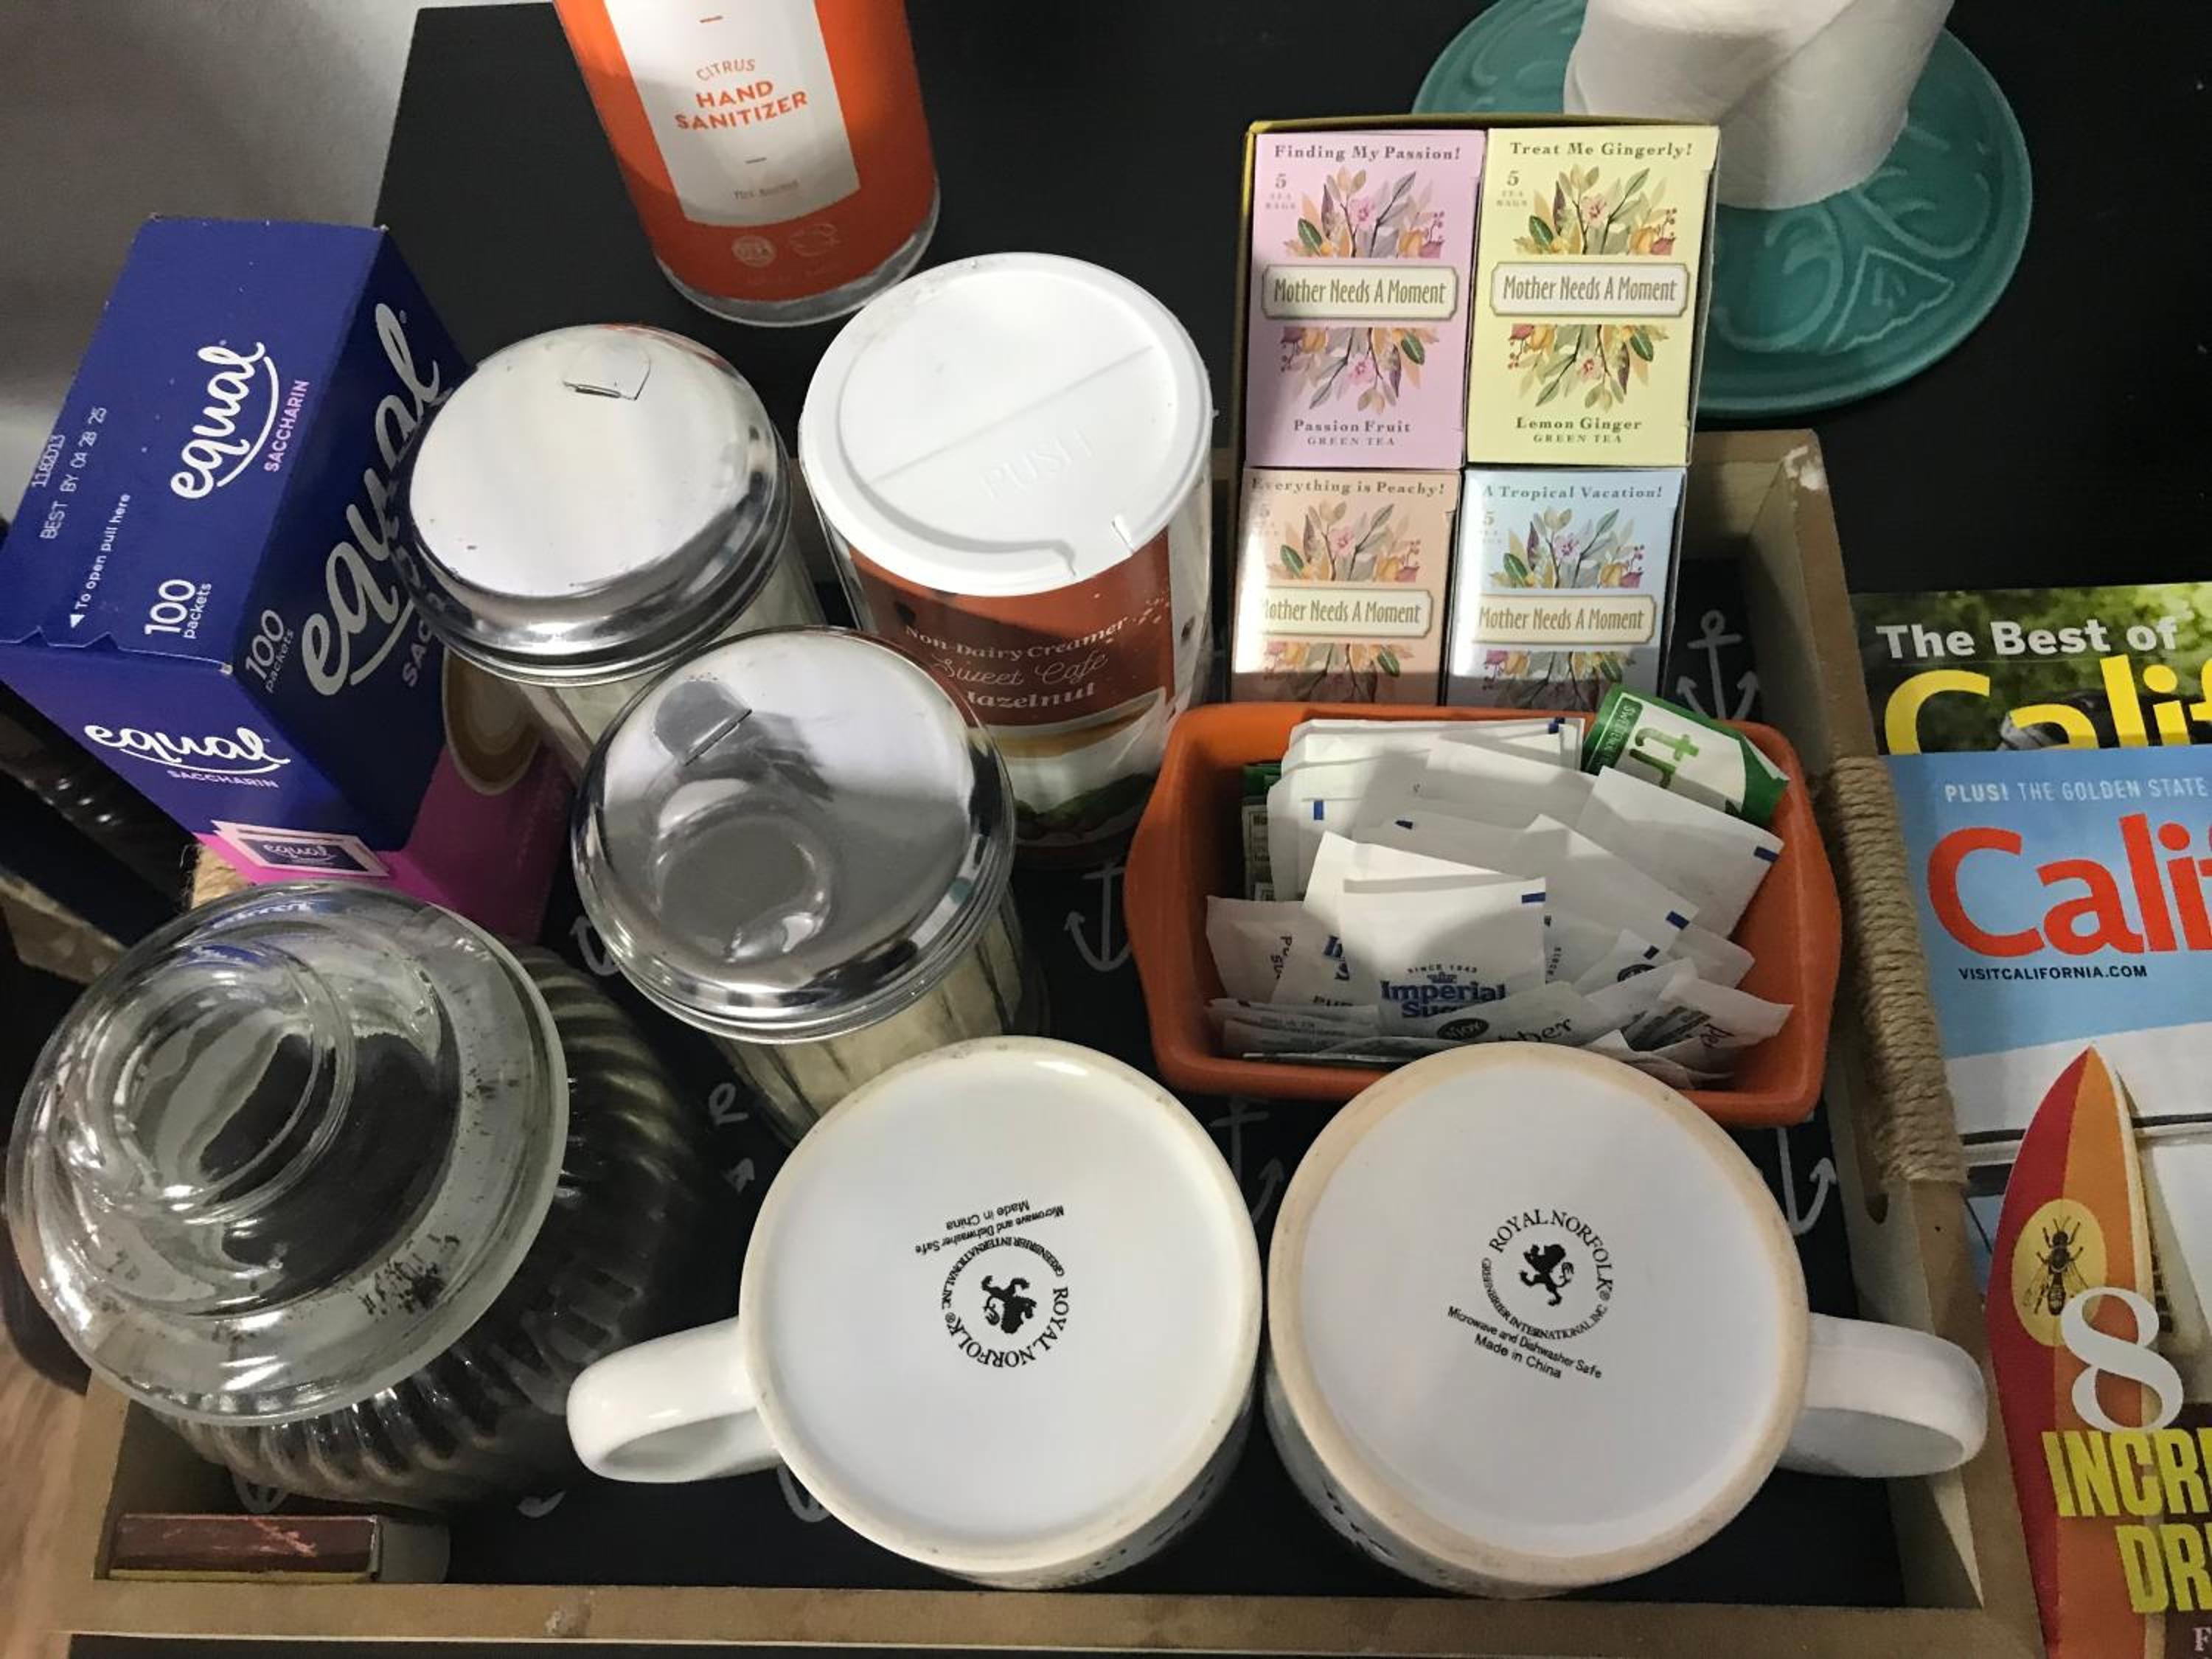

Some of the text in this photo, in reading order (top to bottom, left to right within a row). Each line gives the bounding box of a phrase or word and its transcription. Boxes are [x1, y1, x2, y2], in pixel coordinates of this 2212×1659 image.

[695, 58, 756, 81] CITRUS
[695, 80, 774, 109] HAND
[674, 91, 808, 131] SANITIZER
[1274, 145, 1461, 161] Finding My Passion!
[1510, 142, 1694, 159] Treat Me Gingerly!
[1275, 173, 1287, 189] 5
[1506, 170, 1520, 187] 5
[1273, 278, 1447, 305] Mother Needs A Moment
[1503, 275, 1677, 302] Mother Needs A Moment
[170, 341, 267, 500] equal
[264, 379, 310, 473] SACCHARIN
[1293, 420, 1411, 433] Passion Fruit
[1516, 417, 1643, 434] Lemon Ginger
[1307, 437, 1396, 446] GREEN TEA
[1533, 434, 1622, 443] GREEN TEA
[978, 426, 1097, 501] PUSH
[1357, 481, 1371, 493] is
[1376, 481, 1444, 497] Peachy!
[1482, 485, 1663, 501] A Tropical Vacation!
[39, 501, 68, 539] BEST
[60, 473, 79, 492] BY
[74, 493, 131, 610] To open pull here
[145, 579, 195, 636] 100
[182, 582, 212, 640] packets
[1309, 599, 1349, 623] Needs
[1352, 599, 1361, 622] A
[1366, 599, 1423, 625] Moment
[1479, 606, 1645, 631] Mother Needs A Moment
[246, 610, 285, 680] 100
[906, 616, 1127, 664] Non-Dairy Creamer
[1876, 616, 2179, 660] The Best of
[265, 629, 296, 695] packets
[931, 653, 1025, 686] Sweet
[83, 724, 292, 764] equal
[167, 770, 279, 789] SACCHARIN
[1944, 776, 2208, 804] PLUS! THE GOLDEN STATE
[1408, 964, 1443, 974] SINCE
[1958, 964, 2149, 981] VISITCALIFORNIA.COM
[1380, 979, 1507, 1004] Imperial
[946, 1199, 1030, 1231] Made in China
[914, 1205, 1065, 1256] Microwave and Dishwasher Safe
[1488, 1209, 1549, 1253] ROYAL
[1032, 1286, 1070, 1352] ROYAL
[1447, 1306, 1603, 1379] Microwave and Dishwasher Safe
[1474, 1333, 1562, 1380] Made in China
[2061, 1286, 2185, 1434] 8
